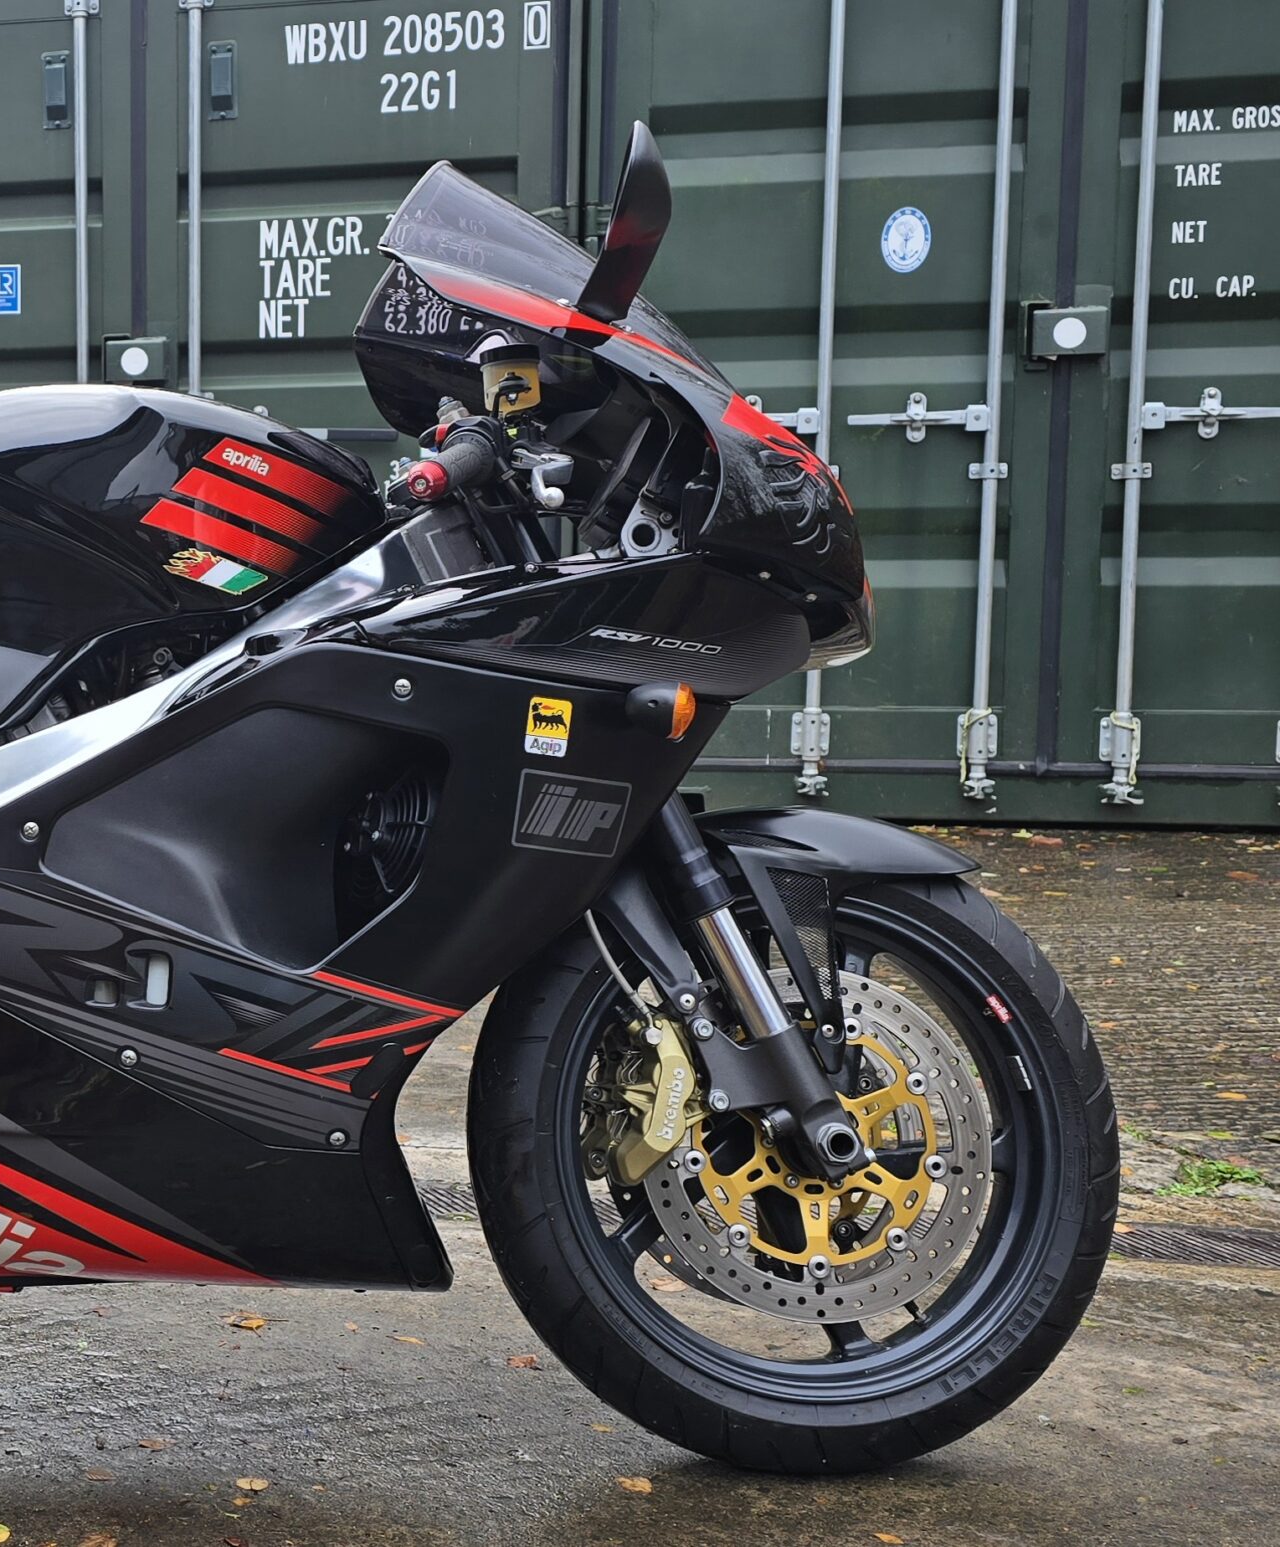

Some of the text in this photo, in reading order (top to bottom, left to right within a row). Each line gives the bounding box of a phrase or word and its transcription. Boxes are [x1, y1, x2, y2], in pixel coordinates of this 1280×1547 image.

[285, 4, 548, 64] WBXU 208503 0
[380, 69, 457, 113] 22G1
[1173, 108, 1221, 133] MAX.
[1174, 163, 1222, 187] TARE
[259, 216, 370, 258] MAX.GR.
[1171, 220, 1207, 244] NET
[259, 258, 332, 298] TARE
[1168, 275, 1256, 299] CU. CAP.
[259, 299, 309, 338] NET
[222, 447, 270, 476] aprilia
[651, 636, 723, 655] 1000
[529, 737, 563, 755] Agip
[656, 1067, 686, 1140] brembo
[937, 1272, 1062, 1397] PIRELLI
